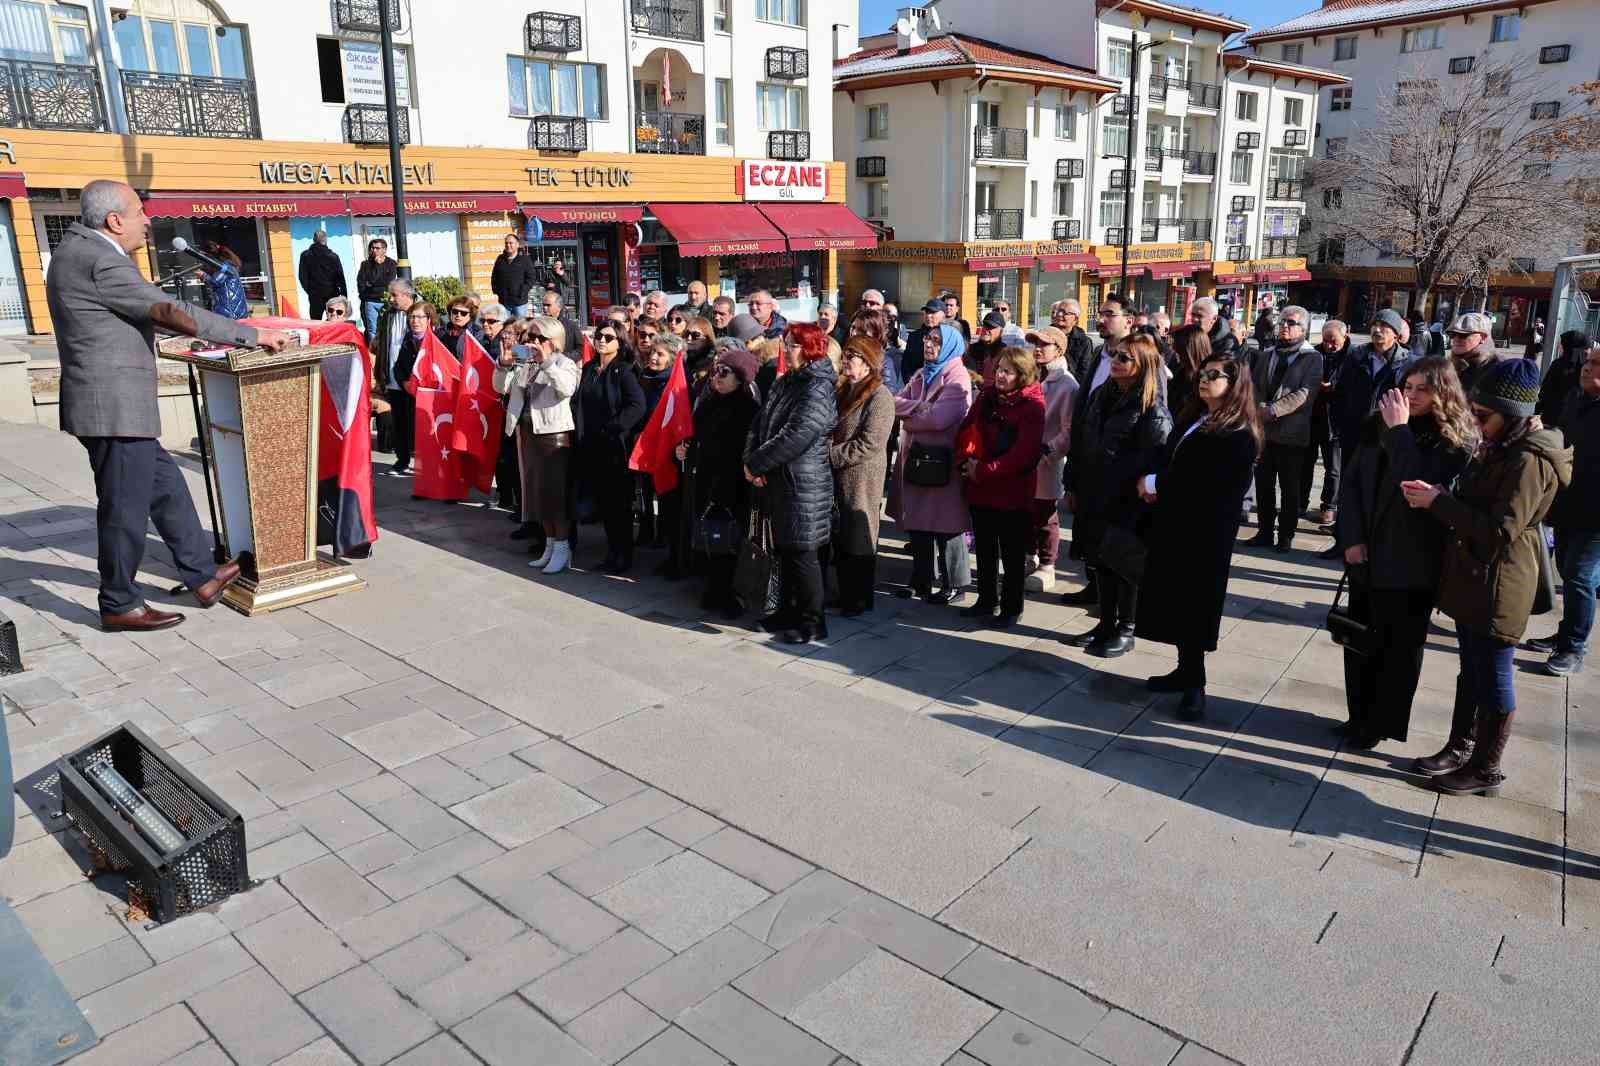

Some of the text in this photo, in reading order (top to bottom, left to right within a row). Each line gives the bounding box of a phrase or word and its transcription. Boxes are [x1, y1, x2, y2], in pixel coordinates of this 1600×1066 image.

[260, 161, 433, 184] MEGA KİTAEVİ
[526, 167, 559, 186] TEK
[750, 164, 822, 187] ECZANE
[779, 187, 794, 198] GÜL
[192, 204, 235, 215] BAŞARI
[404, 200, 477, 211] AŞARI KİTABEVİ
[728, 242, 759, 251] ECZANESİ
